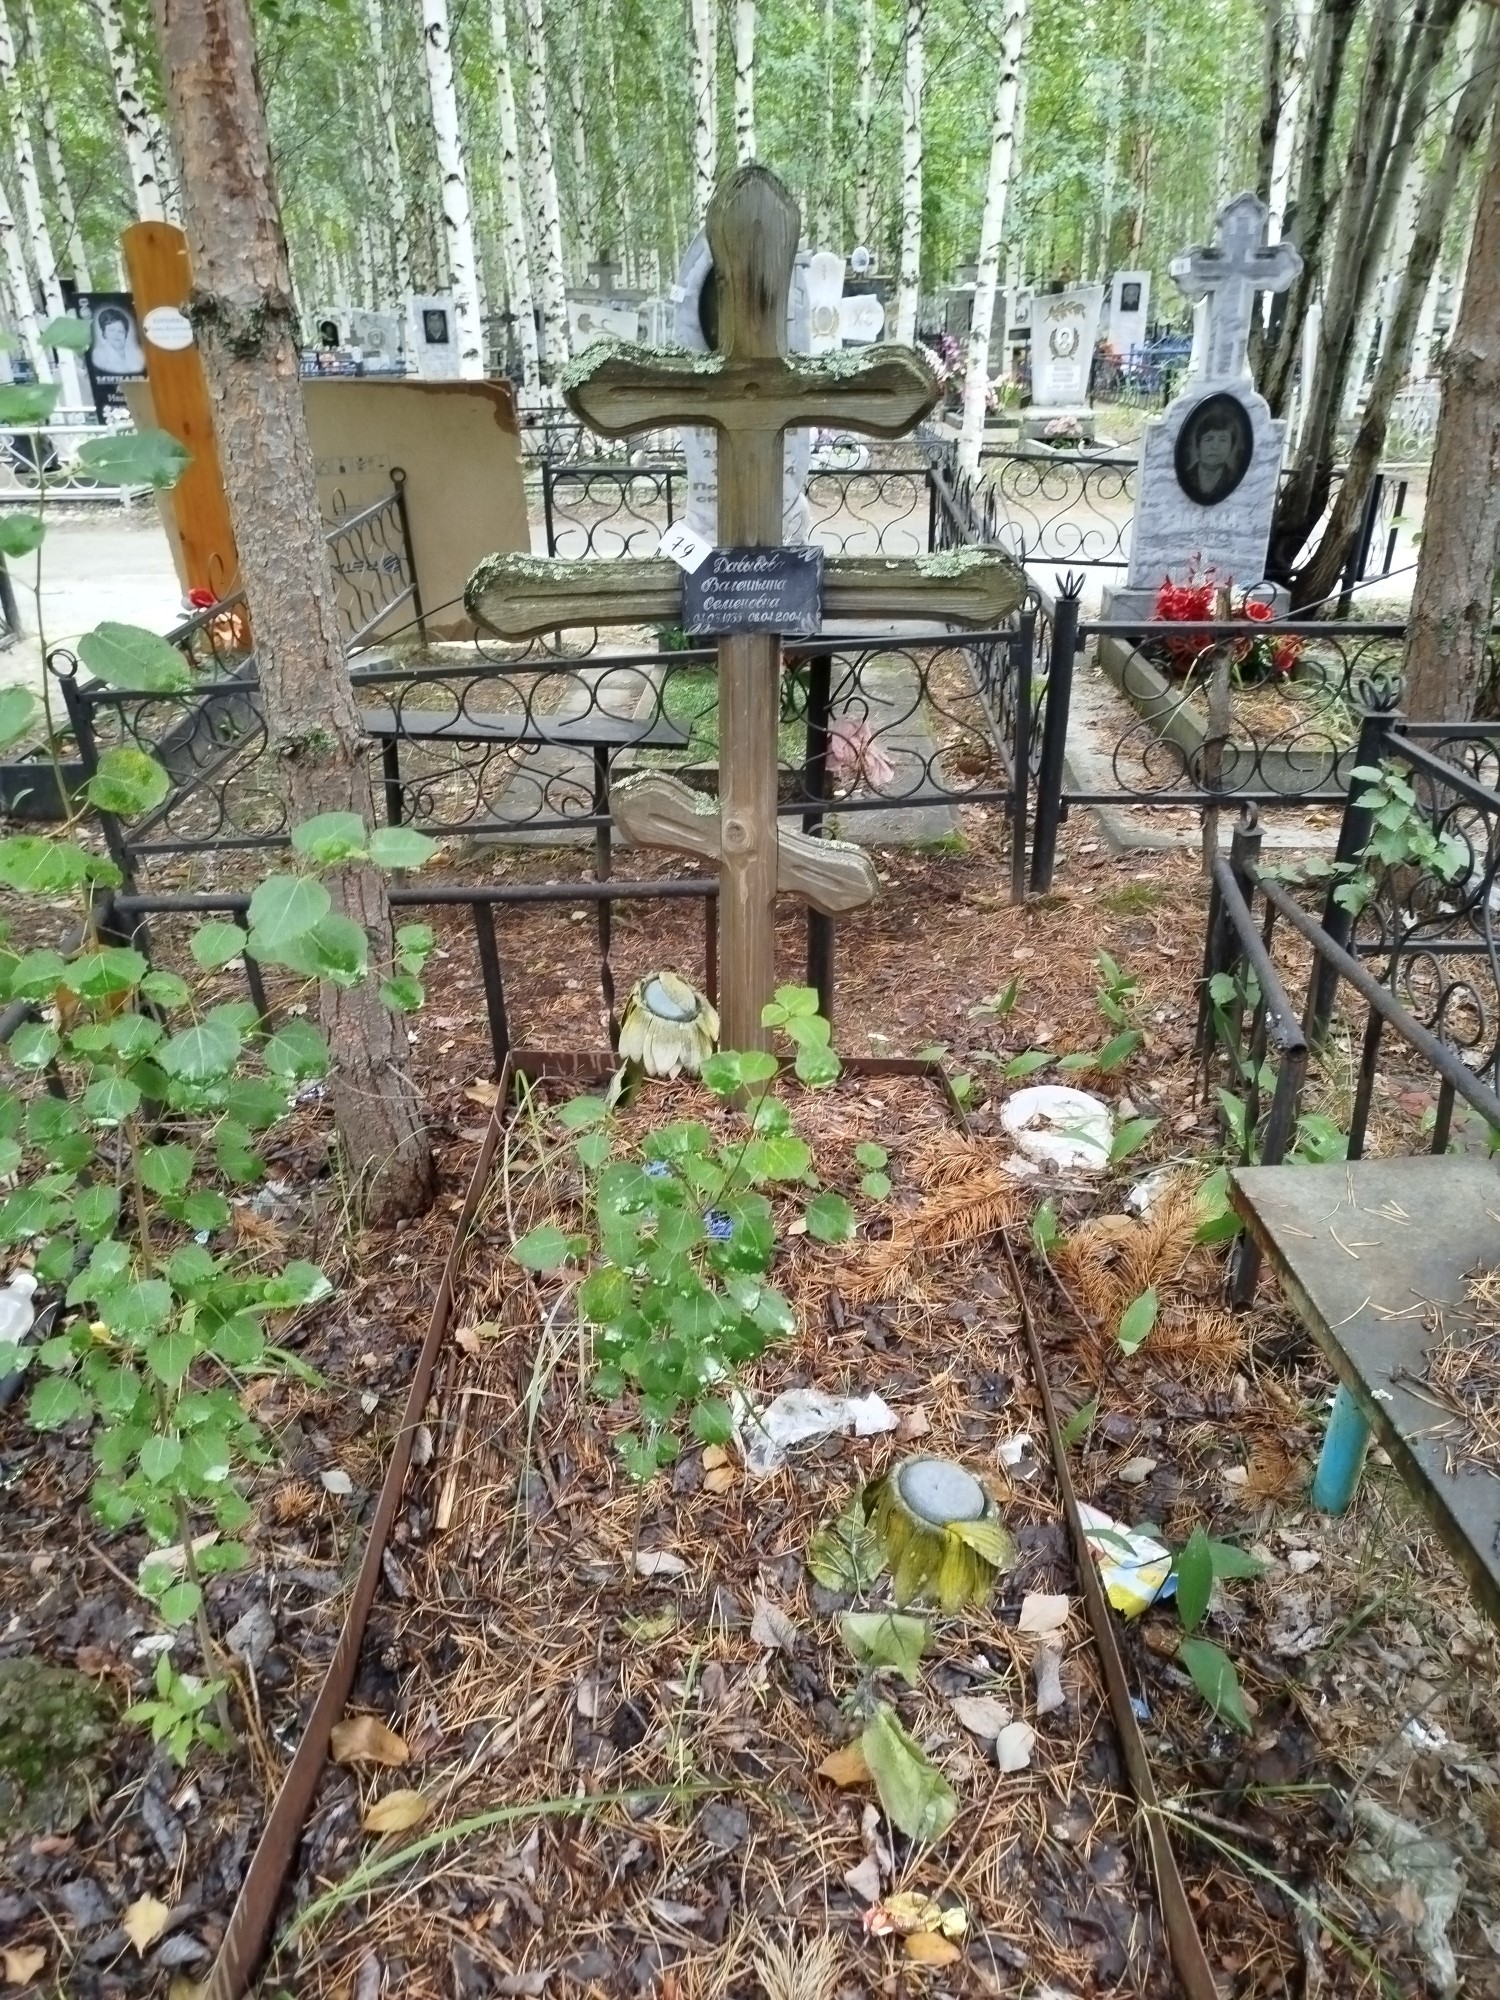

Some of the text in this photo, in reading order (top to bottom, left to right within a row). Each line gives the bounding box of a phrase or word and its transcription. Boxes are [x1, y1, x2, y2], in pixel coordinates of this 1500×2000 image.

[672, 536, 696, 559] 79
[700, 576, 788, 593] Валентина
[703, 593, 780, 611] Семеновна
